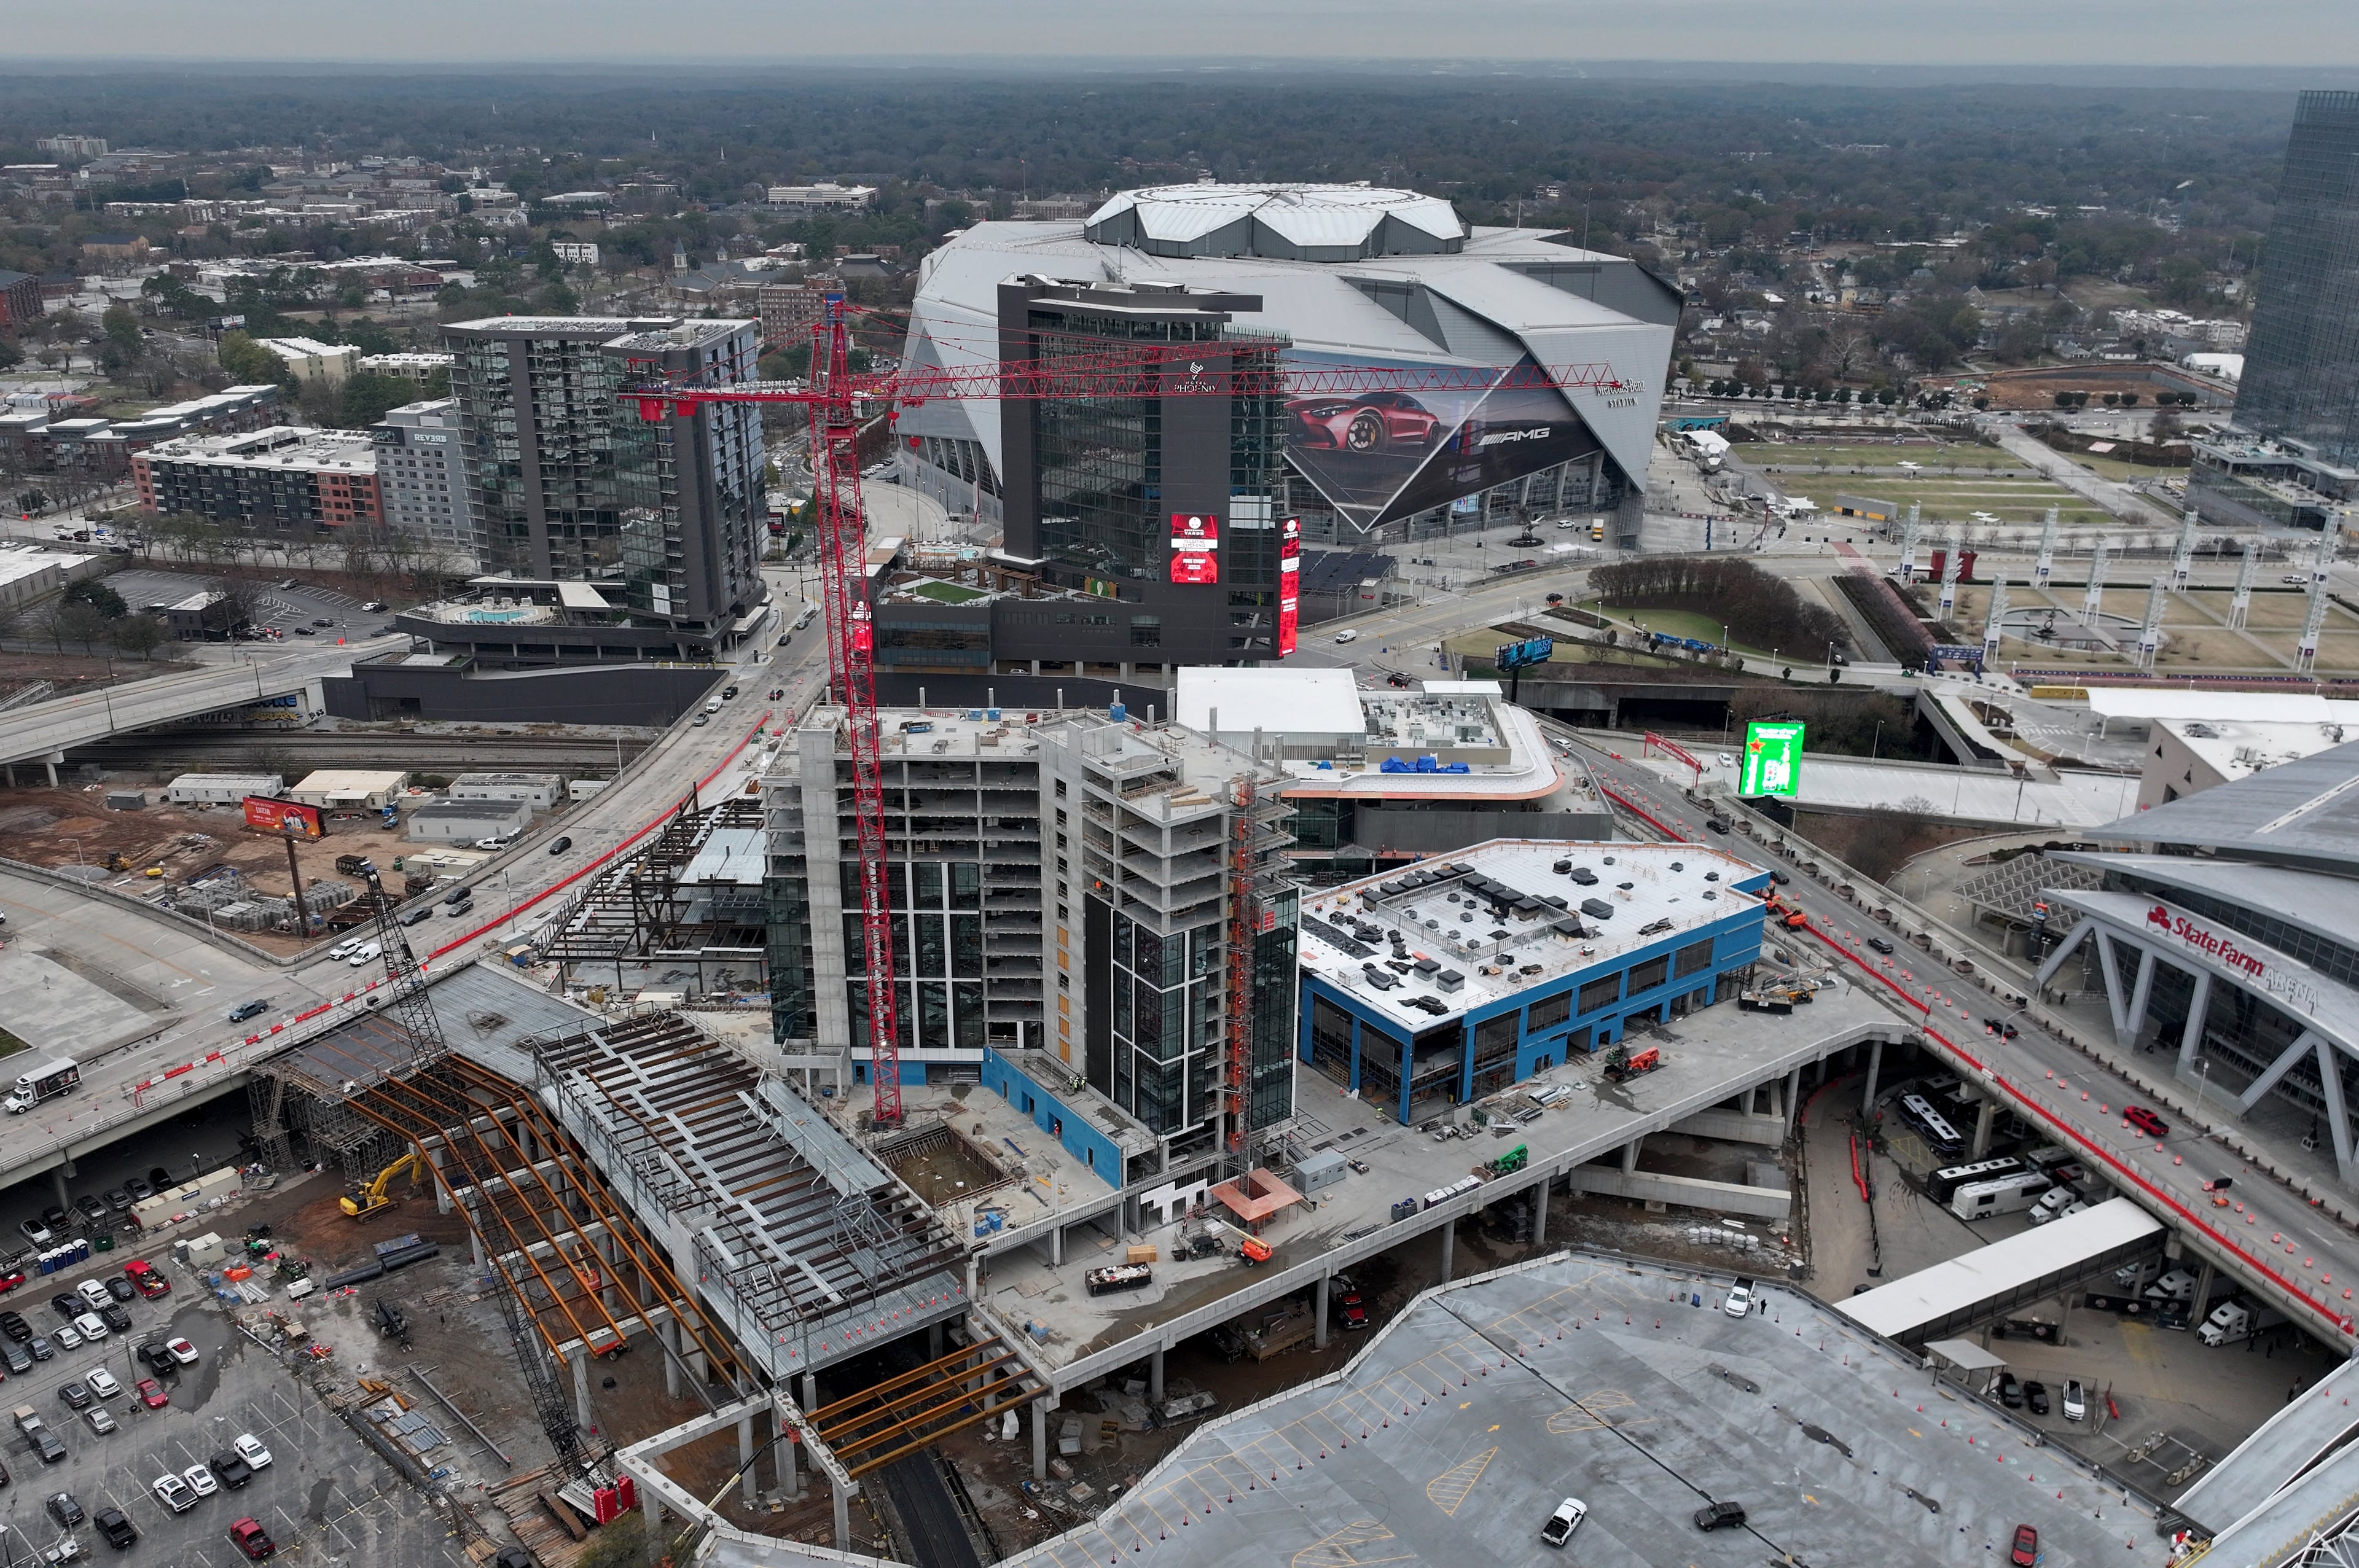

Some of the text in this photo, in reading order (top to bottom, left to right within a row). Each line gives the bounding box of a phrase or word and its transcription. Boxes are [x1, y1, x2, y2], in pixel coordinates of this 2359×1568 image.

[1608, 397, 1639, 408] STADIUM
[1501, 427, 1551, 443] AMG
[1534, 638, 1552, 649] VIKTOR
[1535, 645, 1551, 655] &ROLF
[2172, 917, 2265, 977] State Farm
[385, 953, 394, 969] 248
[2264, 967, 2319, 1007] ARENA
